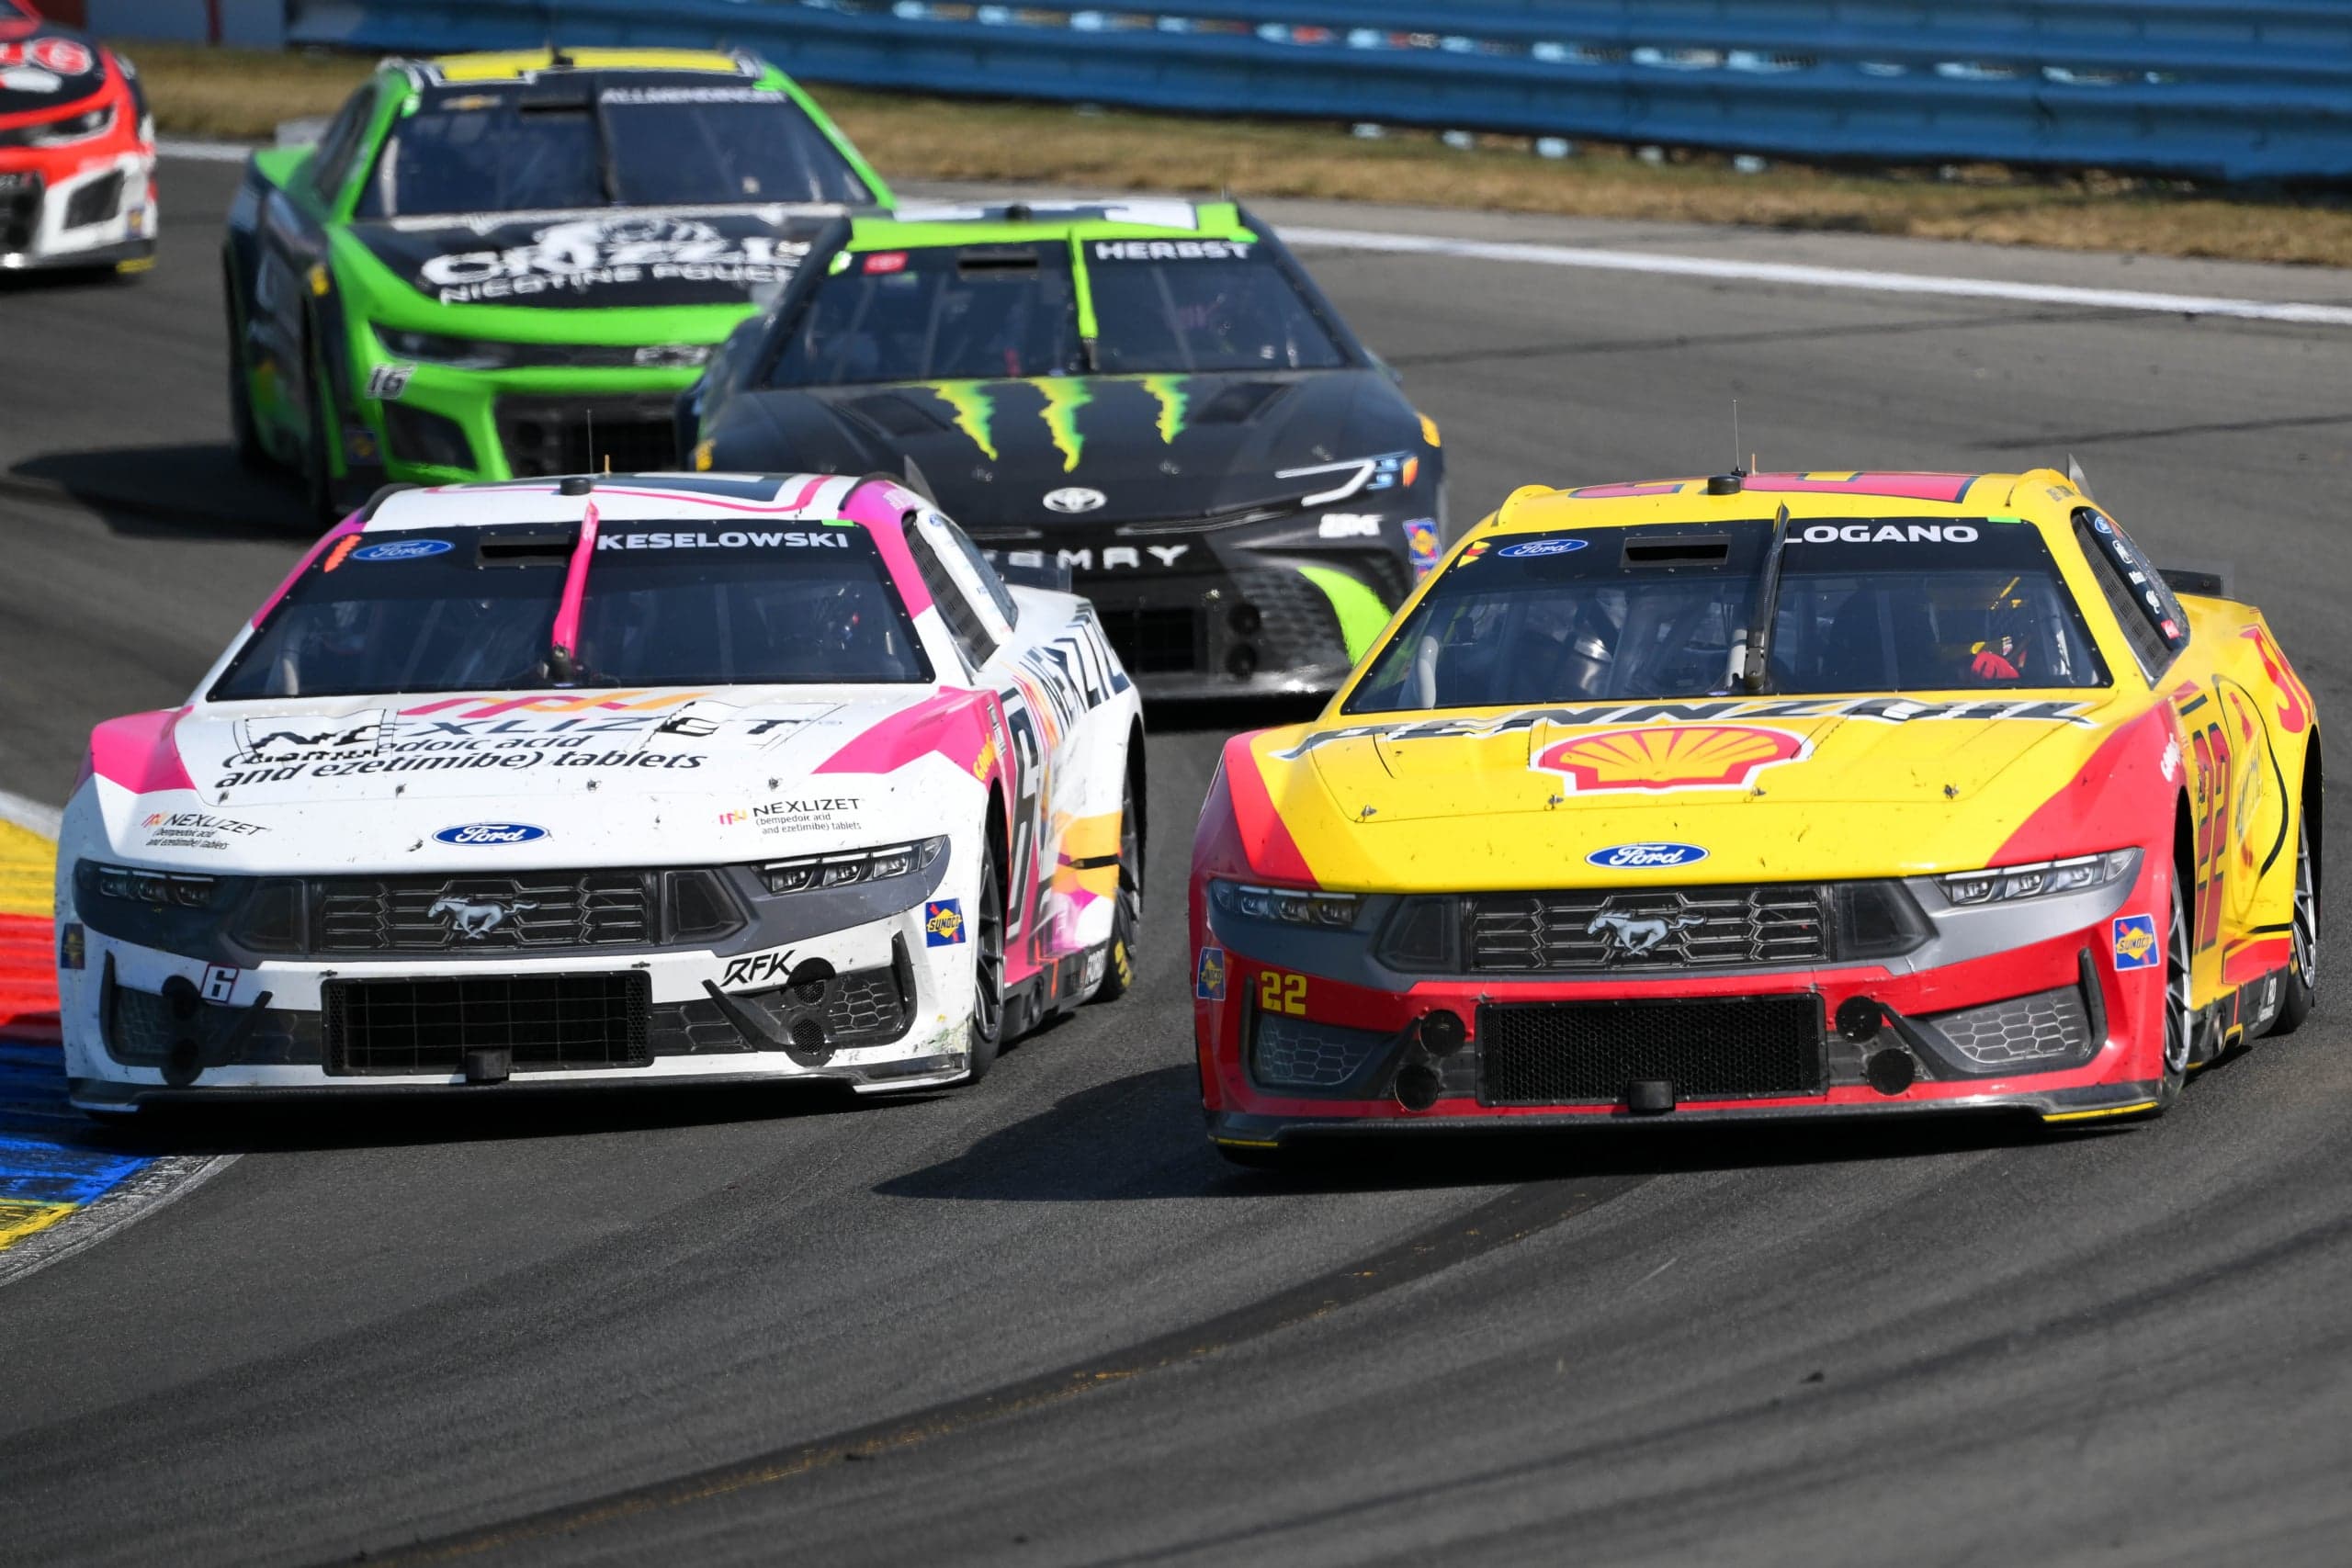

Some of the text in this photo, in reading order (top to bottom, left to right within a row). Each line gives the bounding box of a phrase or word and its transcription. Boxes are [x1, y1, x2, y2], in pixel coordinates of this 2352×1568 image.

[1095, 242, 1249, 260] HERBST
[440, 266, 642, 307] NICOTINE
[369, 542, 434, 558] Ford
[597, 532, 848, 550] KESELOWSKI
[1514, 541, 1572, 555] Ford
[250, 715, 814, 750] NEXLIZET
[496, 735, 594, 749] acid
[215, 749, 708, 788] and ezetimibe) tablets
[753, 798, 860, 817] NEXLIZET
[164, 813, 267, 836] NEXLIZET
[756, 813, 831, 826] (bempedoic acid
[762, 826, 780, 835] and
[832, 821, 862, 830] tablets
[455, 825, 527, 842] Ford
[1609, 845, 1685, 865] Ford
[720, 949, 796, 987] RFK
[200, 963, 240, 1004] 6
[1261, 971, 1306, 1015] 22
